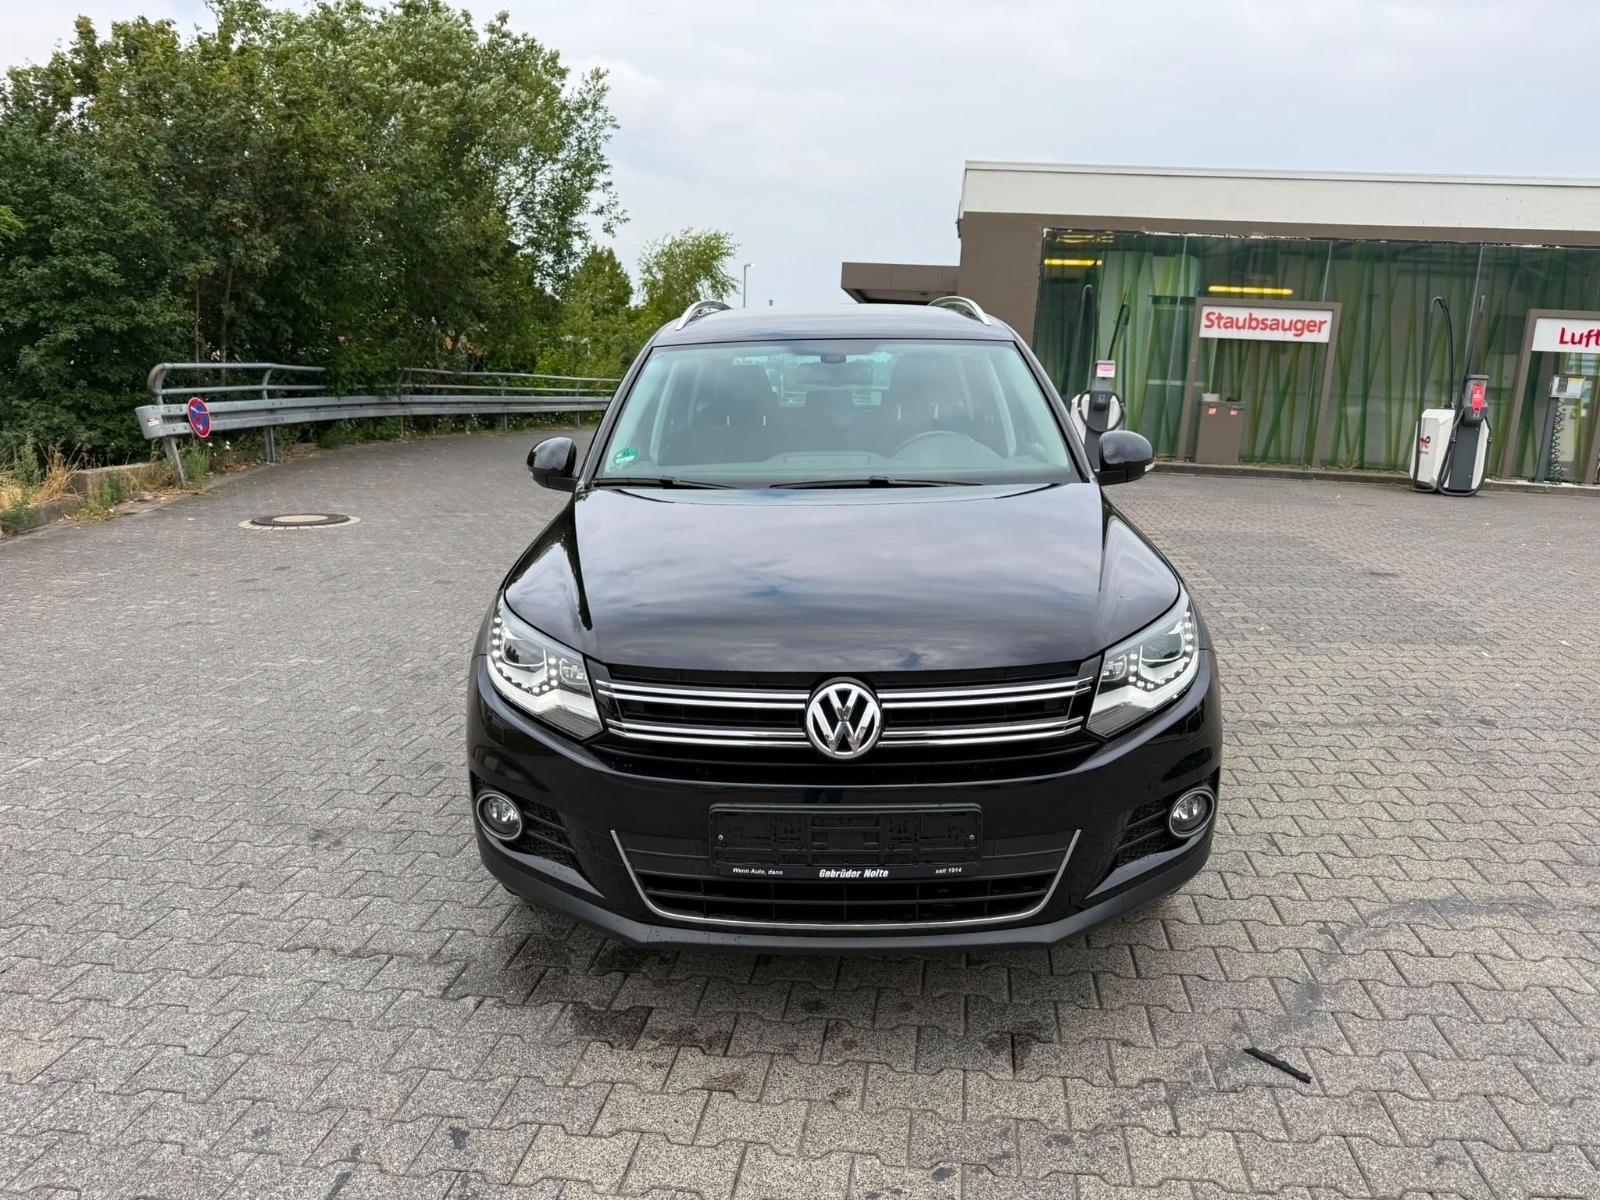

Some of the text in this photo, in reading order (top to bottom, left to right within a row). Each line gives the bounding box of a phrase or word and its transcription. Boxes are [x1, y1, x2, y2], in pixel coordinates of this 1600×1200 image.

[1203, 310, 1328, 338] Staubsauger
[1558, 326, 1600, 348] Luft
[808, 683, 879, 756] VW
[818, 868, 862, 878] Gebrüder
[863, 868, 889, 878] Nolte
